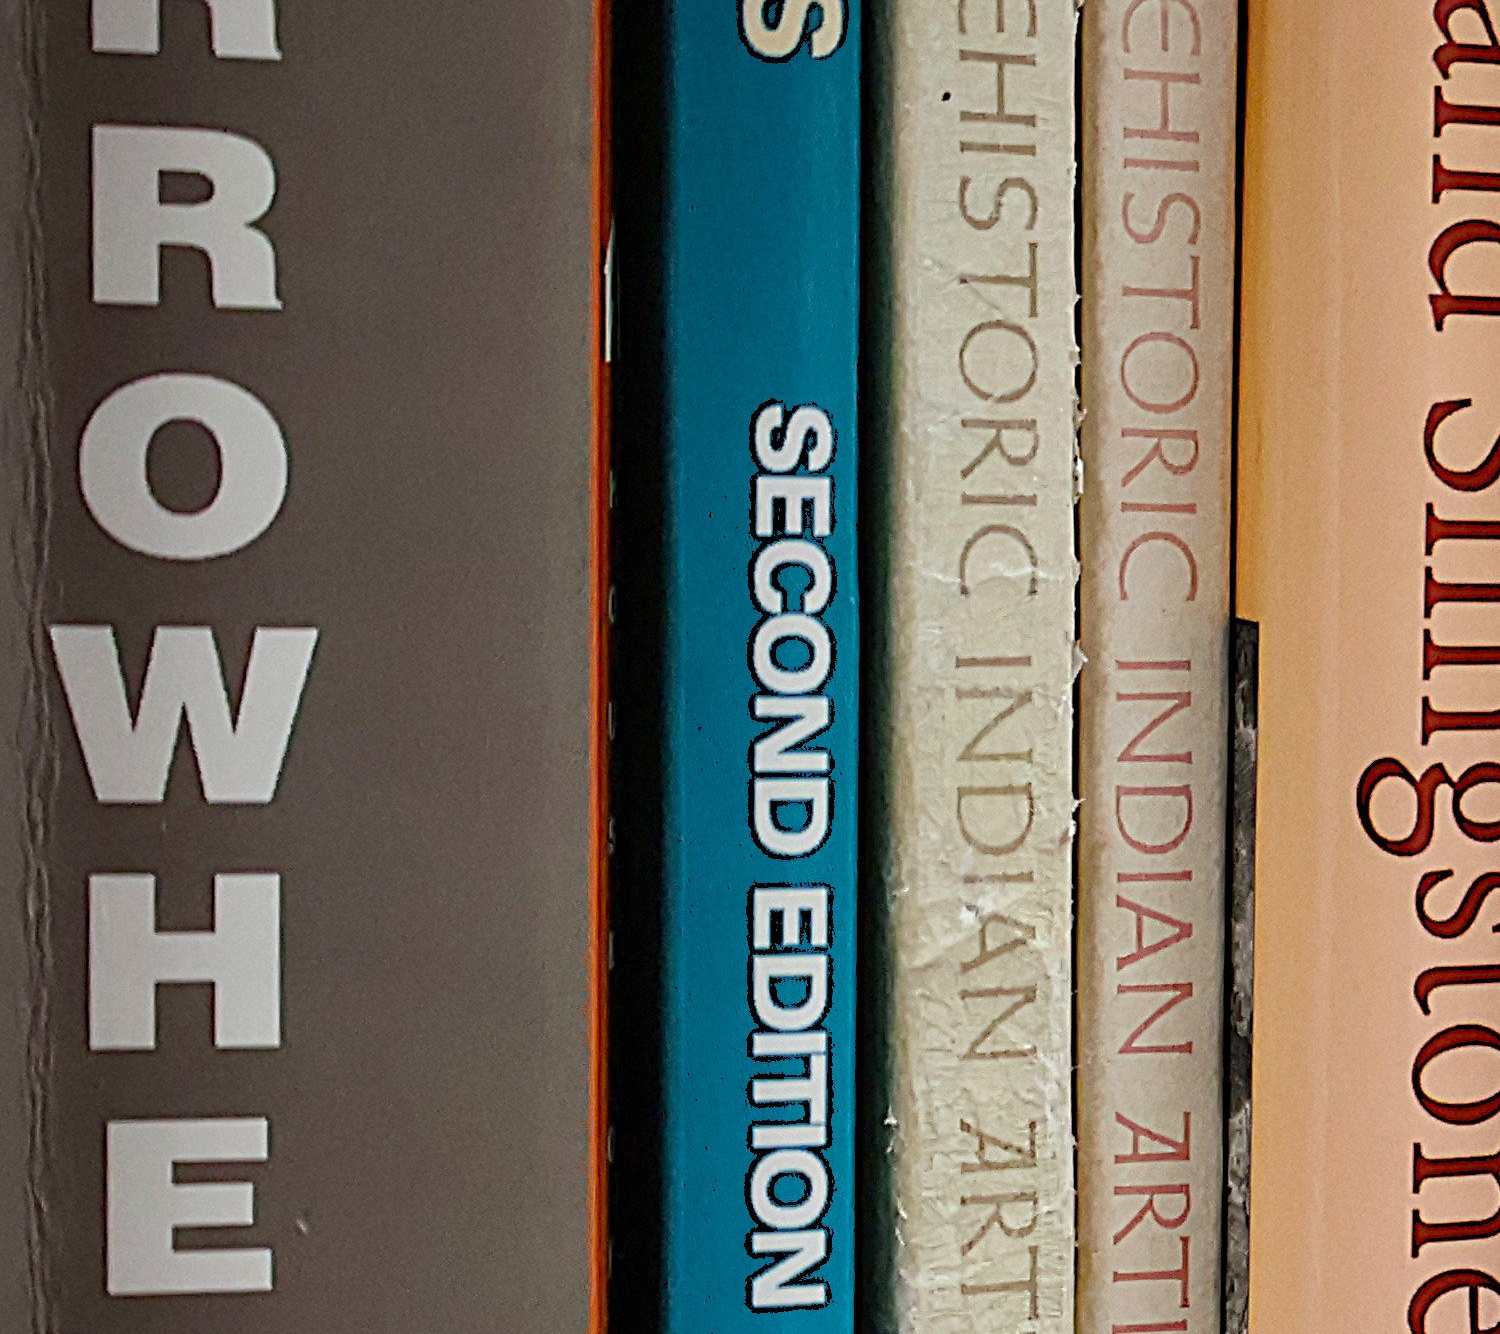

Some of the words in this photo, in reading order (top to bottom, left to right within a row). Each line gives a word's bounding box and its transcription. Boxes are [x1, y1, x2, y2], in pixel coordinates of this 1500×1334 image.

[750, 402, 834, 858] SECOND
[955, 654, 1039, 1062] INDIAN
[1113, 658, 1197, 1055] INDIAN
[747, 884, 833, 1314] EDITION
